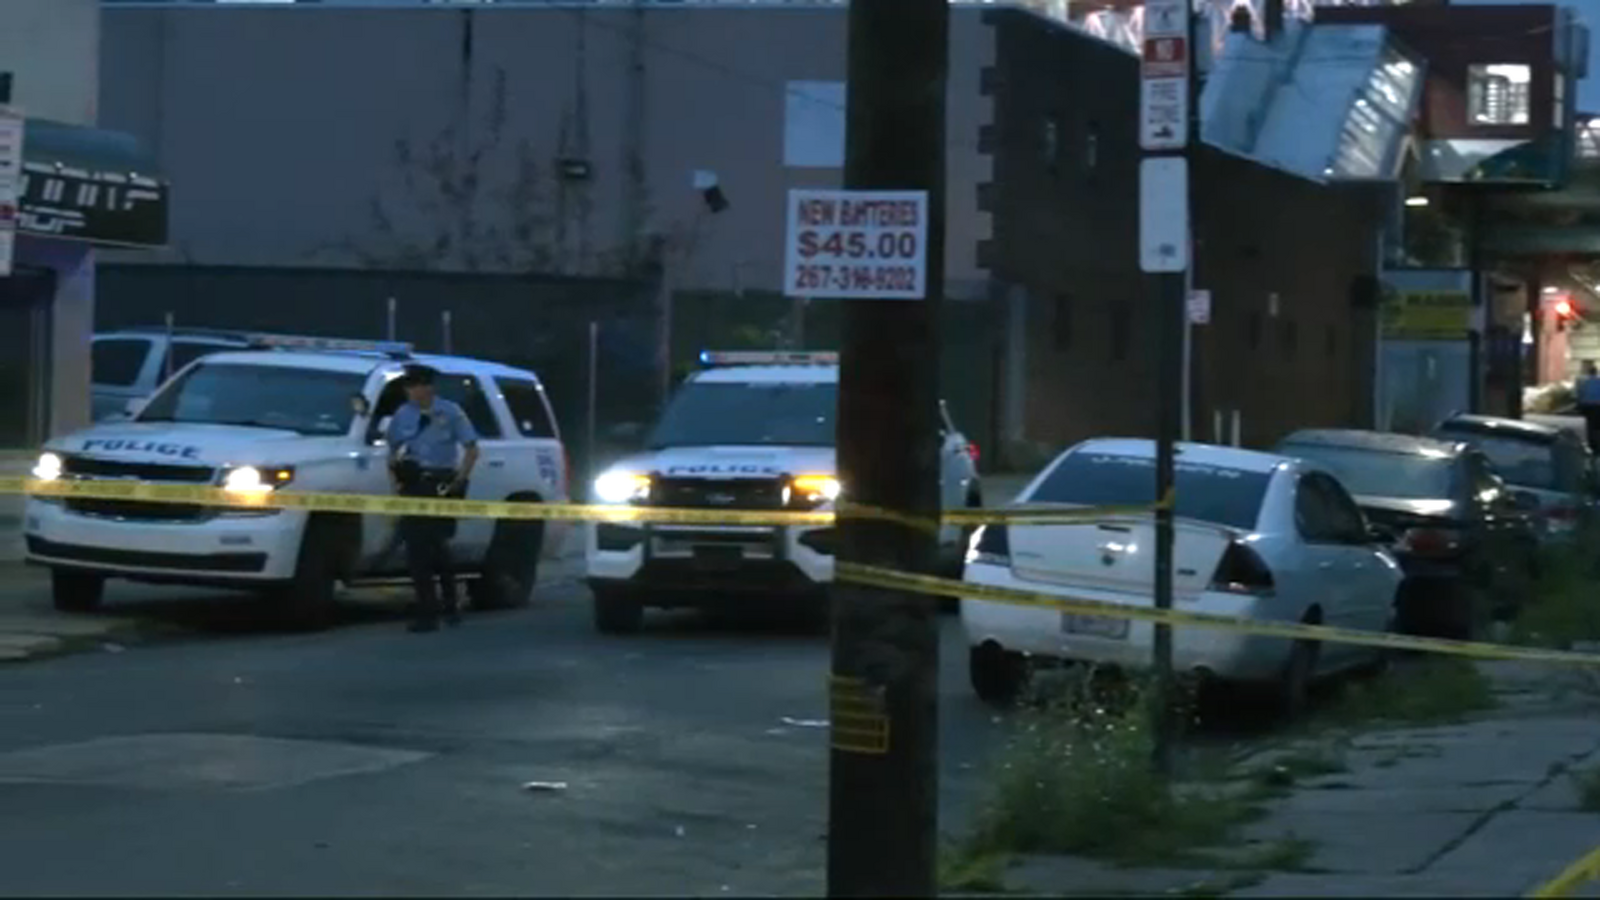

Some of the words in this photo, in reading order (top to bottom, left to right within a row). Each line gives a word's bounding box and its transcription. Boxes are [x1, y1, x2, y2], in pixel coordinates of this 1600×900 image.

[799, 200, 835, 226] NEW
[798, 230, 917, 259] $45.00
[82, 438, 201, 460] POLICE
